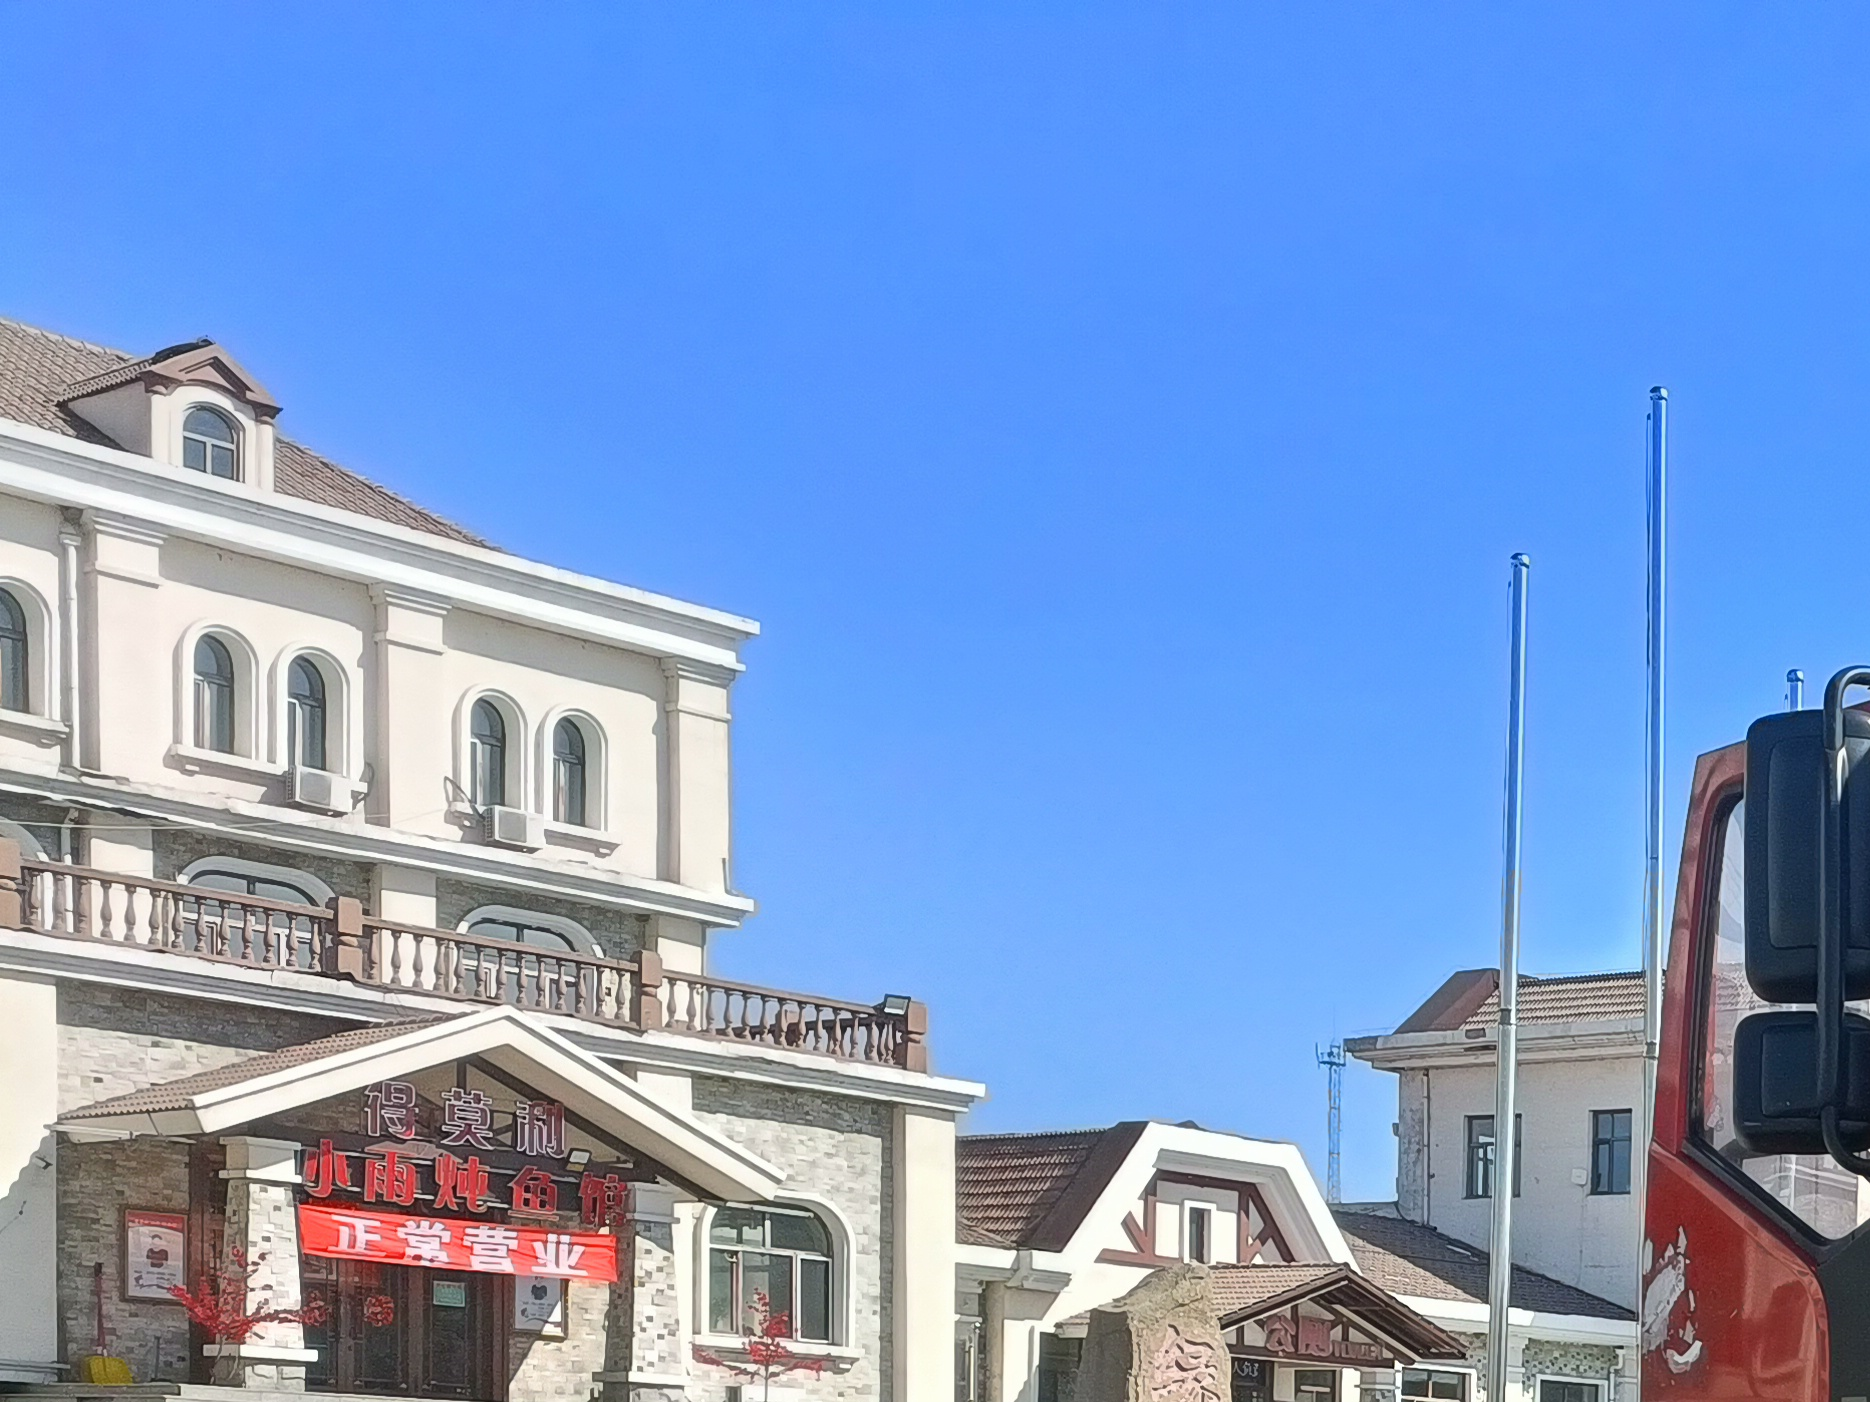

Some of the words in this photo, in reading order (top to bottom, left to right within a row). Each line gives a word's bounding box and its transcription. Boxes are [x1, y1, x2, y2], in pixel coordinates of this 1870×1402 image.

[364, 1081, 566, 1158] 得莫利
[301, 1138, 629, 1227] 小雨炖鱼馆
[329, 1213, 590, 1277] 正常营业
